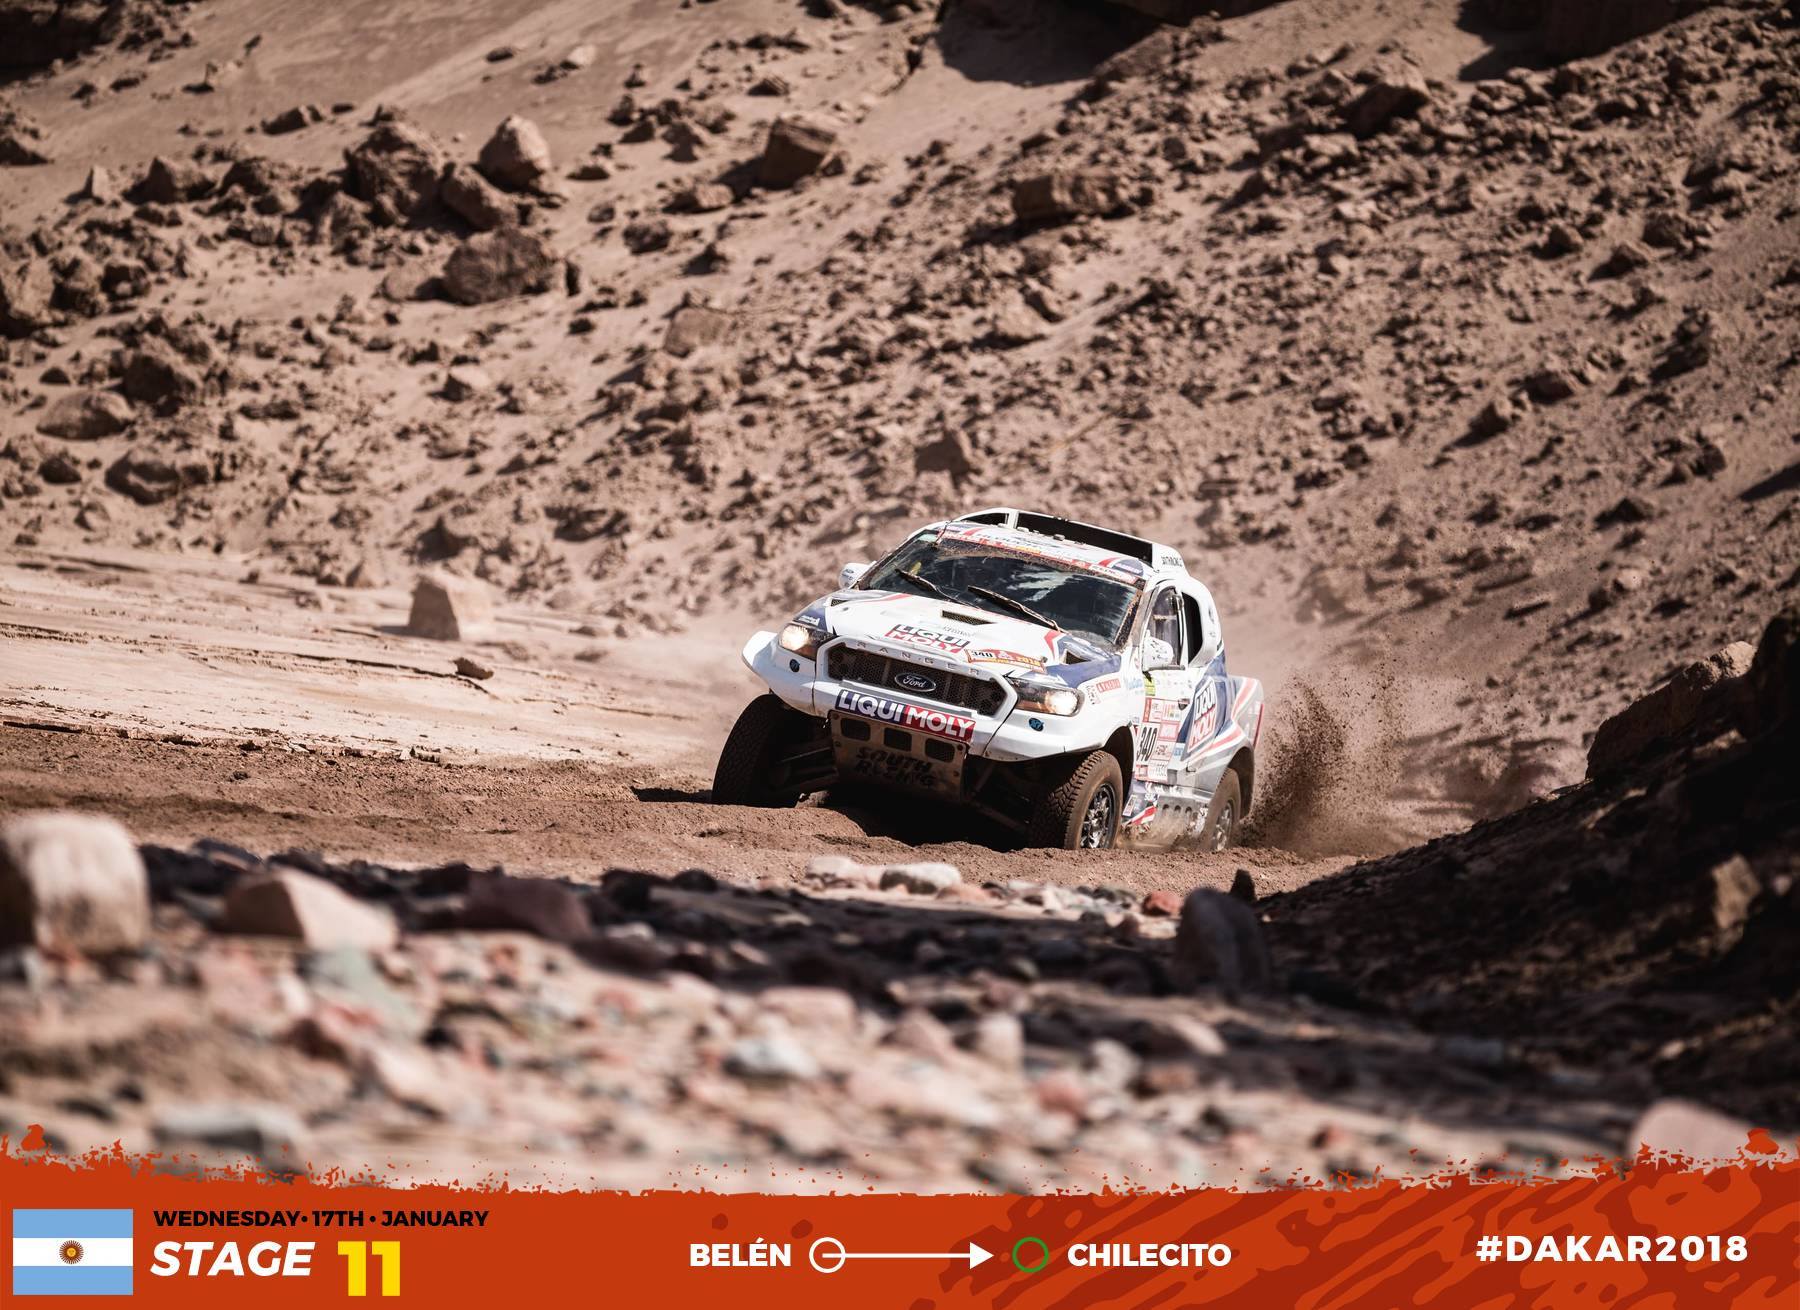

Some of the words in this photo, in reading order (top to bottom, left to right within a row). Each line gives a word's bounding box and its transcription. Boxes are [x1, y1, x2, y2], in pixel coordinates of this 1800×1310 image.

[886, 630, 965, 654] MOLY
[895, 624, 970, 648] LIQUI
[857, 641, 980, 676] RANGER
[901, 675, 927, 688] Ford
[838, 690, 905, 723] LIQUI
[905, 708, 976, 739] MOLY
[1136, 726, 1158, 762] 340
